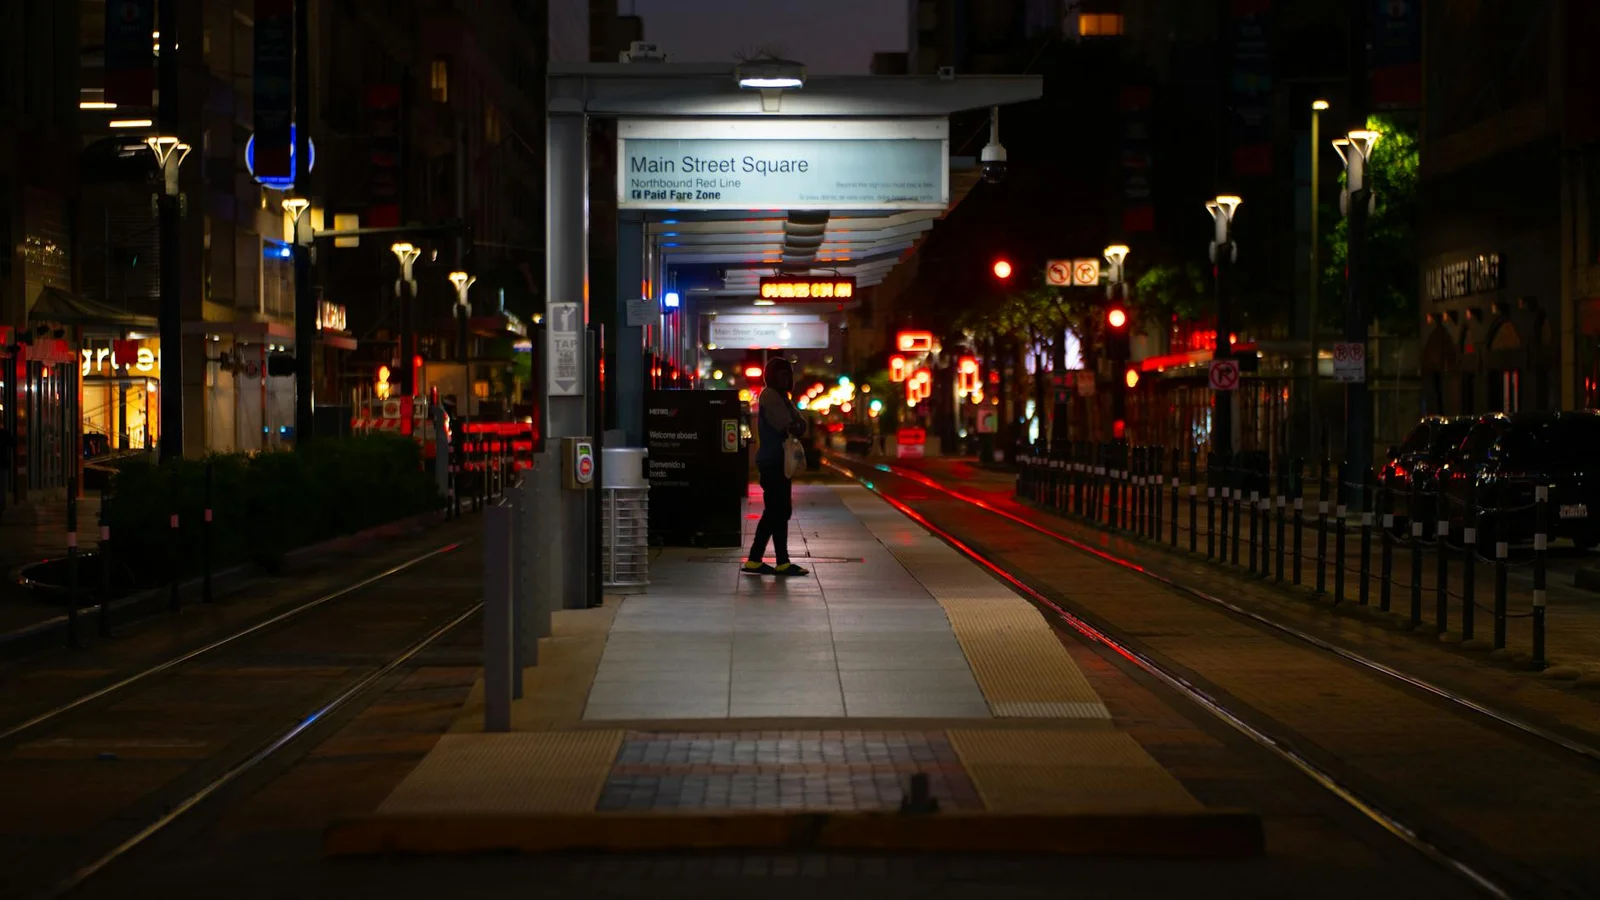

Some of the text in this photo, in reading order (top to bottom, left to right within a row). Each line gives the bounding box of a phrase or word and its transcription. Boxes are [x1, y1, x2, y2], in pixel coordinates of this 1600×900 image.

[631, 156, 808, 177] Main Street Square
[631, 179, 741, 189] Northbound Red Line
[644, 190, 721, 200] Paid Fare Zone
[554, 340, 578, 349] TAP
[650, 431, 676, 440] Welcome
[650, 460, 681, 469] Bienvenido
